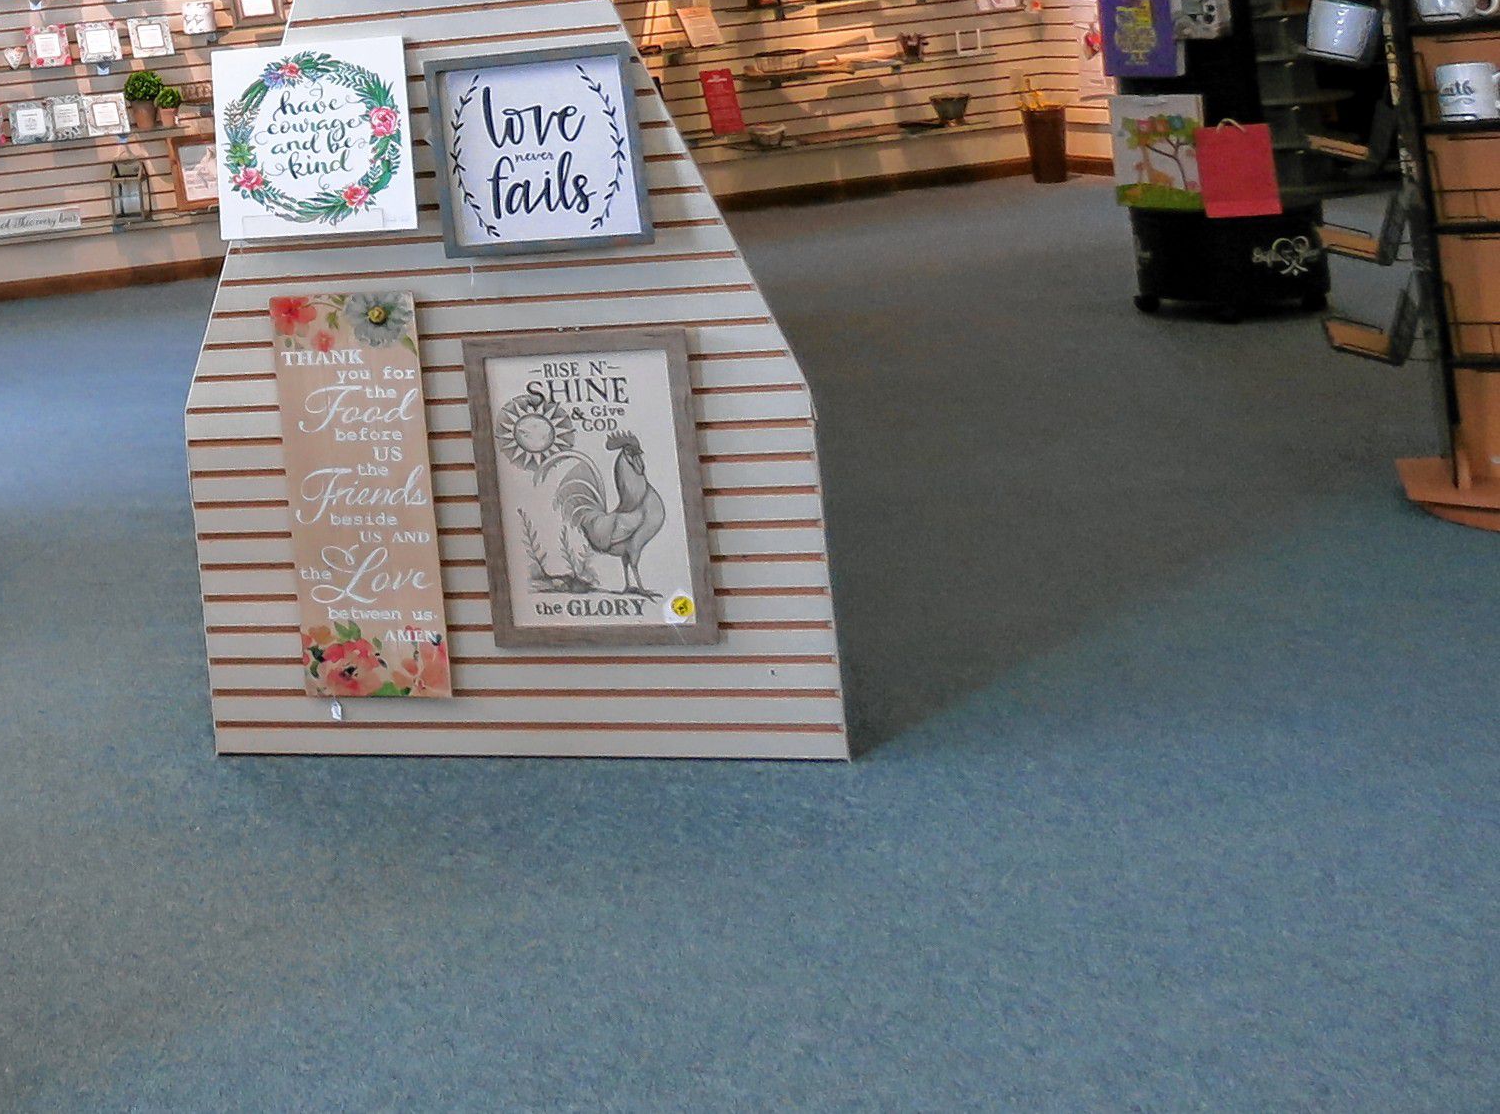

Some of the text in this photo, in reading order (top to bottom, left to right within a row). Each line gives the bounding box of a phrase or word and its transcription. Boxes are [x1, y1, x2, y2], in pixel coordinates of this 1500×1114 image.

[273, 91, 346, 121] have
[482, 86, 586, 148] love
[265, 118, 362, 142] courage
[271, 131, 355, 154] and be
[287, 150, 353, 180] kind
[514, 151, 555, 162] never
[486, 151, 597, 219] fails
[281, 349, 364, 366] THANK
[336, 366, 415, 384] you for
[543, 362, 580, 378] RISE
[365, 385, 397, 398] the
[526, 377, 629, 406] SHINE
[298, 386, 418, 433] Food
[571, 405, 625, 420] & Give
[582, 418, 617, 432] GOD
[335, 427, 403, 441] before
[373, 446, 403, 461] US
[357, 463, 389, 476] the
[296, 464, 427, 524] Friends
[330, 512, 398, 526] beside
[359, 531, 430, 543] US AND
[301, 545, 434, 604] the Love
[328, 606, 402, 620] between
[535, 599, 645, 616] the GLORY
[385, 630, 438, 642] AMEN
